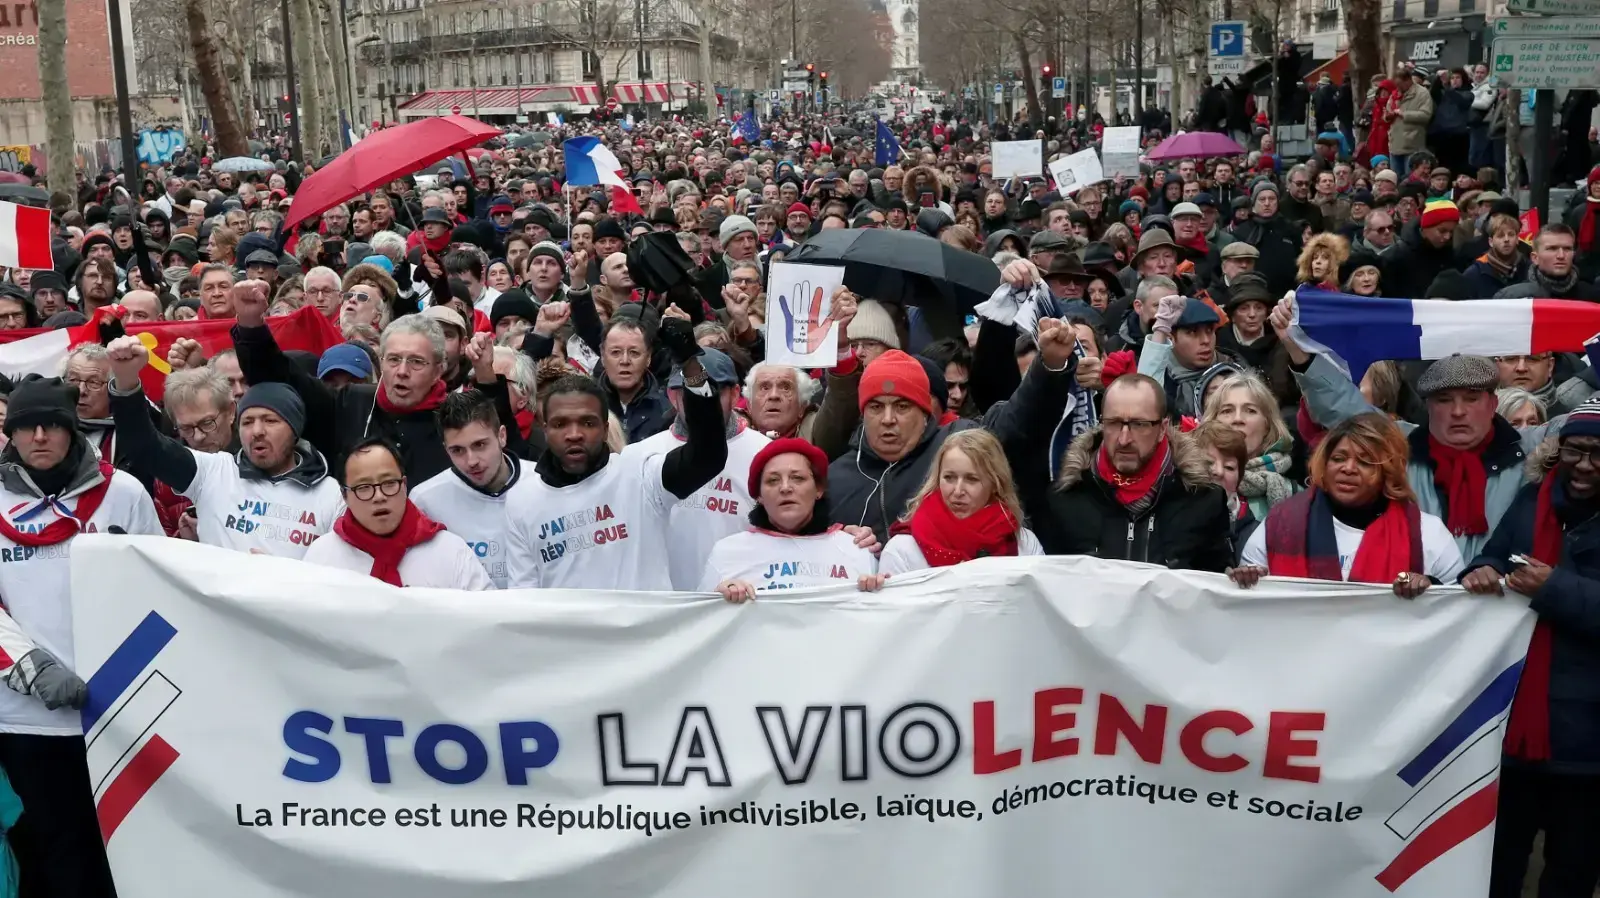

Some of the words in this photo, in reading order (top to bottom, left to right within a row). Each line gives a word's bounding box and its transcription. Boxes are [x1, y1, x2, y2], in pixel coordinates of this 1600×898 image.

[1219, 29, 1235, 51] P
[1409, 40, 1445, 60] BOSE
[1520, 43, 1543, 51] GARE
[1549, 43, 1561, 51] DE
[1565, 43, 1589, 51] LYON
[1519, 53, 1541, 61] GARE
[237, 499, 292, 521] J'AIME
[293, 509, 317, 527] MA
[538, 509, 587, 540] J'AIME
[586, 504, 615, 523] MA
[540, 523, 629, 563] RÉPUBLIQUE
[282, 710, 560, 786] STOP
[597, 706, 732, 788] LA
[755, 687, 1326, 786] VIOLENCE
[236, 803, 273, 827] La
[282, 802, 387, 828] France
[394, 803, 442, 828] est
[451, 808, 508, 829] une
[517, 803, 692, 838] République
[700, 797, 866, 827] indivisible,
[876, 793, 983, 823] laïque,
[991, 774, 1198, 815] démocratique
[1206, 789, 1239, 810] et
[1246, 797, 1363, 823] sociale
